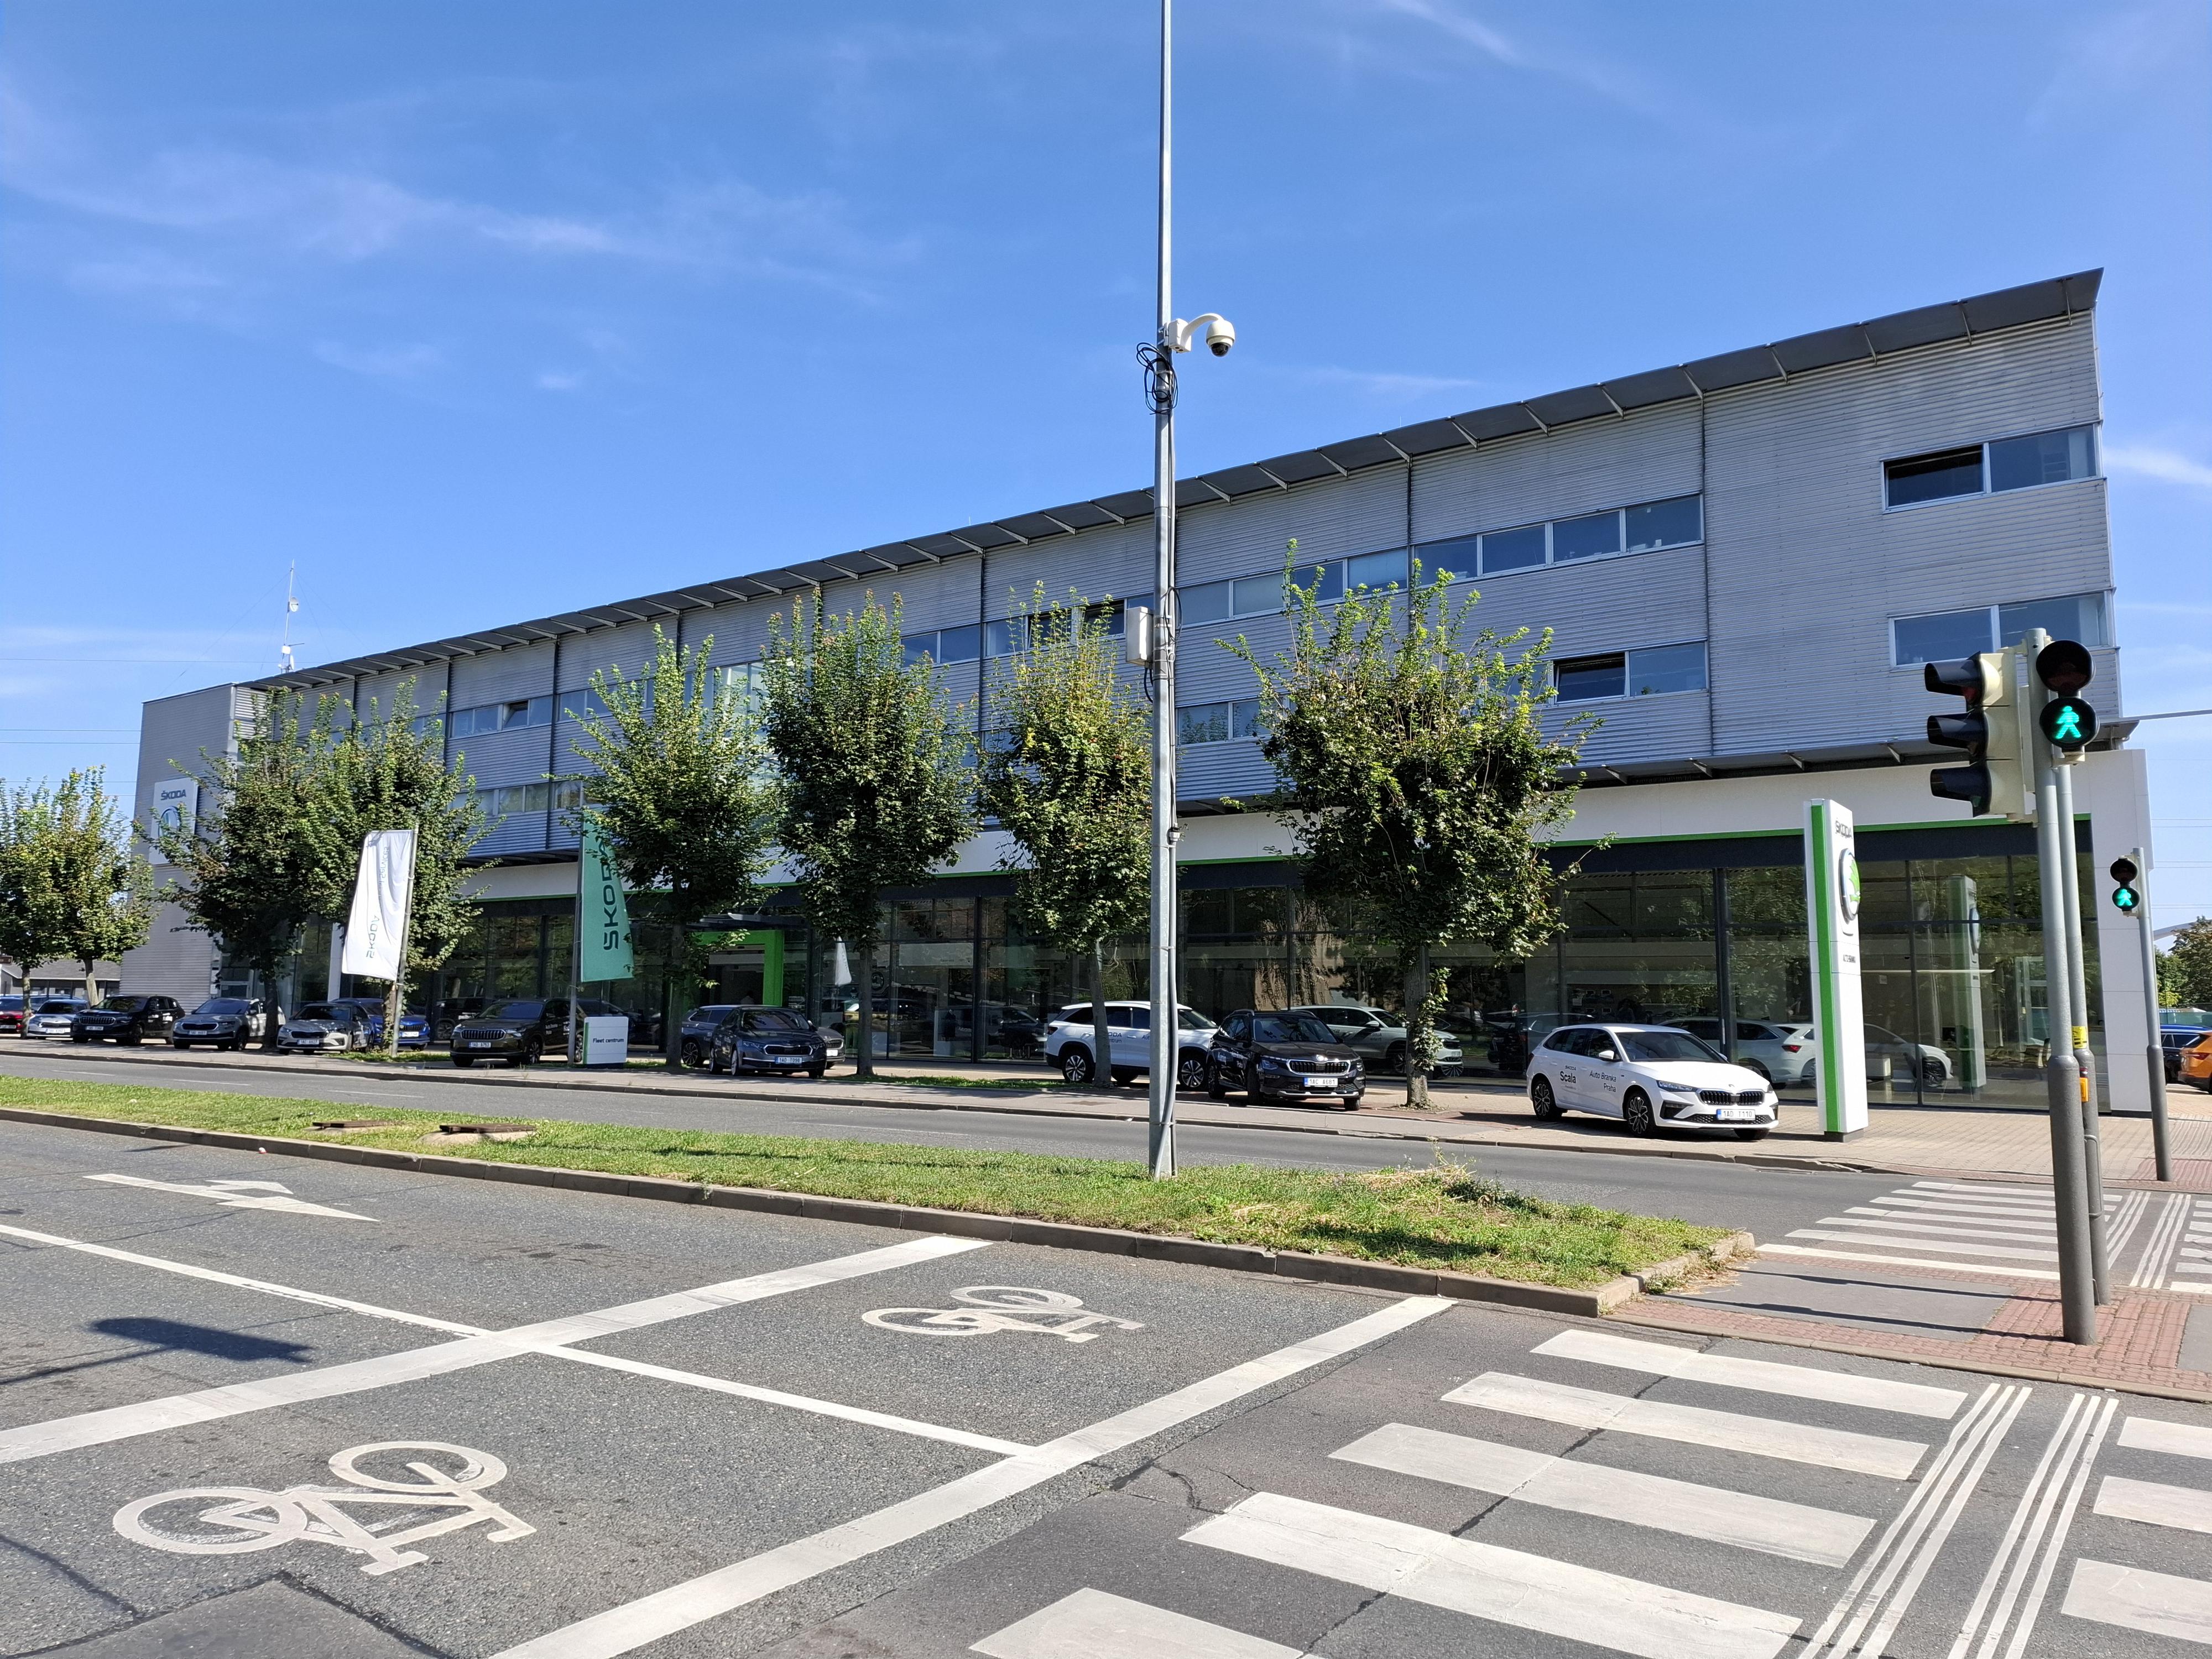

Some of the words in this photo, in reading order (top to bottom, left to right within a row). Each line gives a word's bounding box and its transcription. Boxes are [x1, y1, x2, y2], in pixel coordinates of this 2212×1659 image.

[160, 790, 186, 800] ŠKODA
[1560, 1071, 1576, 1084] Scala
[1589, 1070, 1600, 1079] Auto
[1601, 1072, 1616, 1082] Branka
[1604, 1083, 1616, 1092] Praha
